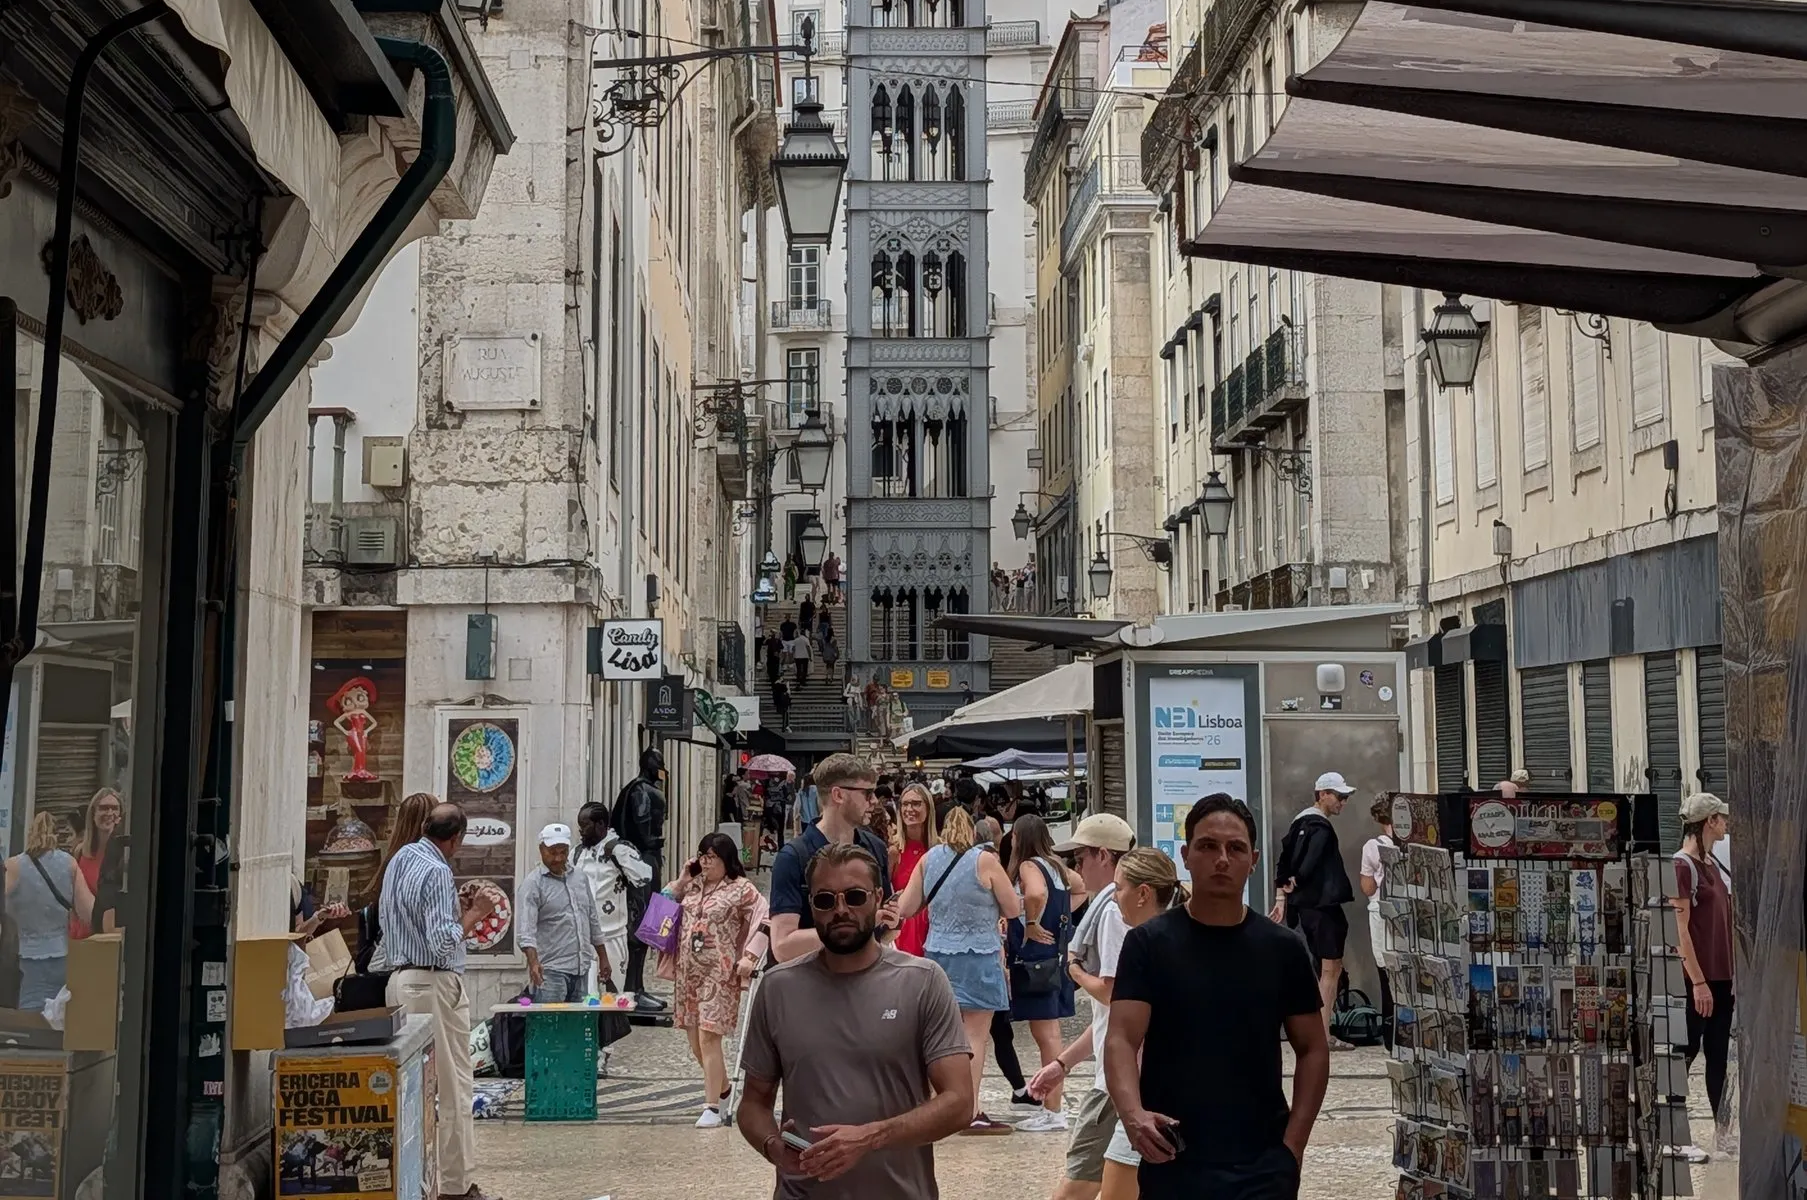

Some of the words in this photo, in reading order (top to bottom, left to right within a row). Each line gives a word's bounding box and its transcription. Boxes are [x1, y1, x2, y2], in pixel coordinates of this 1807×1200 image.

[607, 627, 659, 651] Candy
[607, 647, 658, 672] Lisa
[1198, 714, 1243, 729] Lisboa
[280, 1072, 361, 1091] ERICEIRA
[280, 1089, 342, 1108] YOGA
[279, 1105, 395, 1127] FESTIVAL
